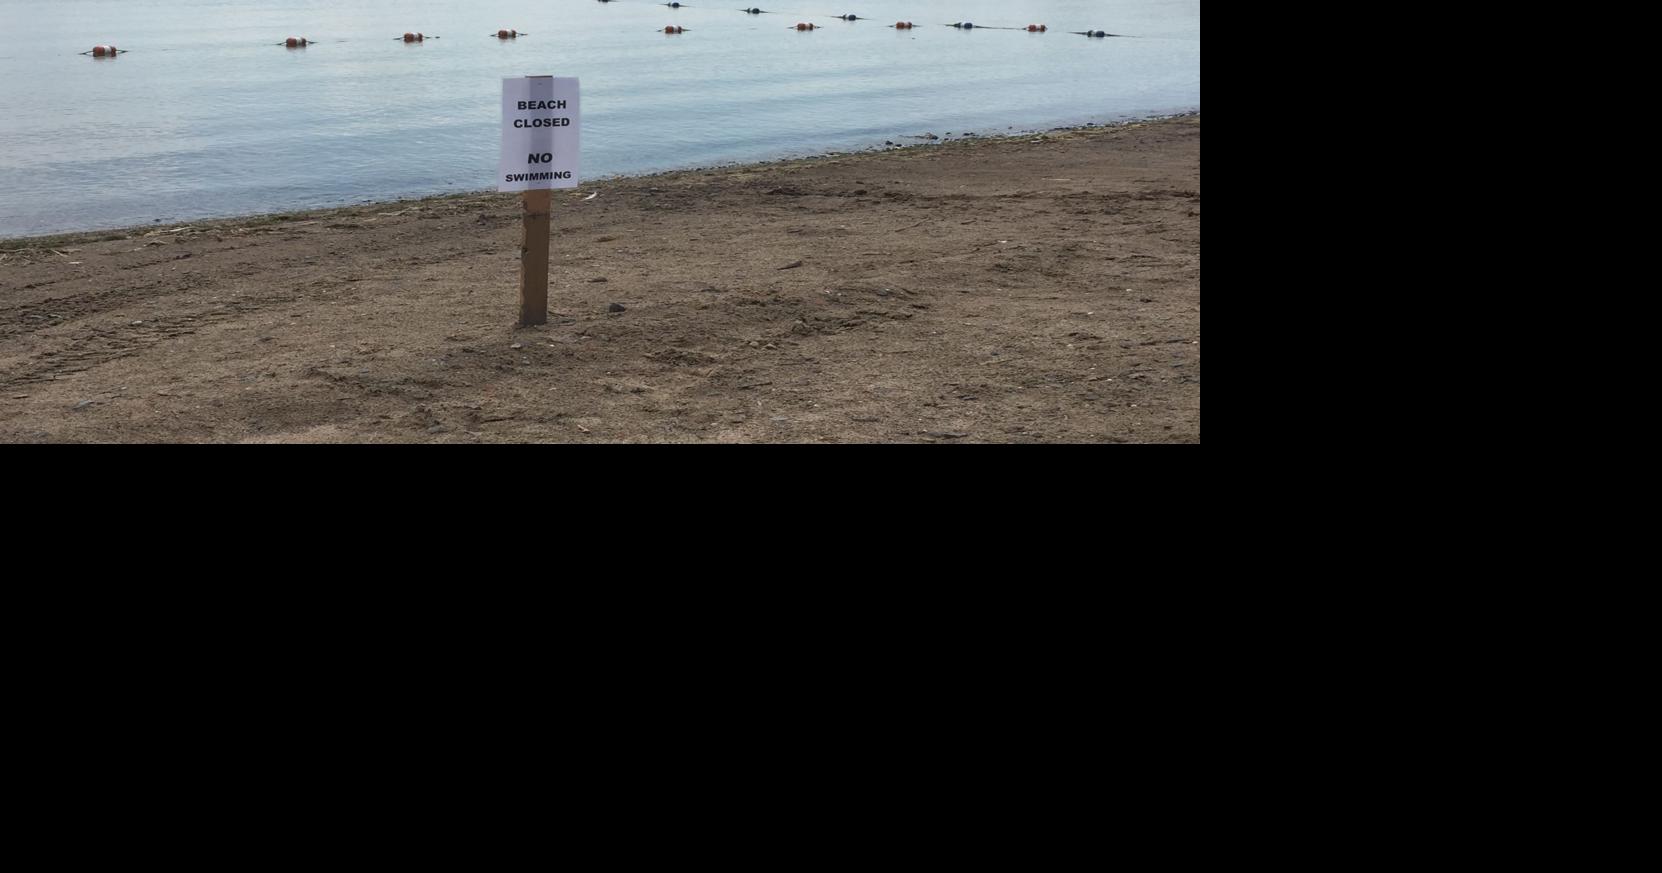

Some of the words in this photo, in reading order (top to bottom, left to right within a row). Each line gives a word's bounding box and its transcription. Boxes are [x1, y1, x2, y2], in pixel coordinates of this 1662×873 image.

[517, 100, 567, 110] BEACH
[513, 117, 570, 128] CLOSED
[527, 152, 553, 164] NO
[505, 171, 572, 182] SWIMMING
